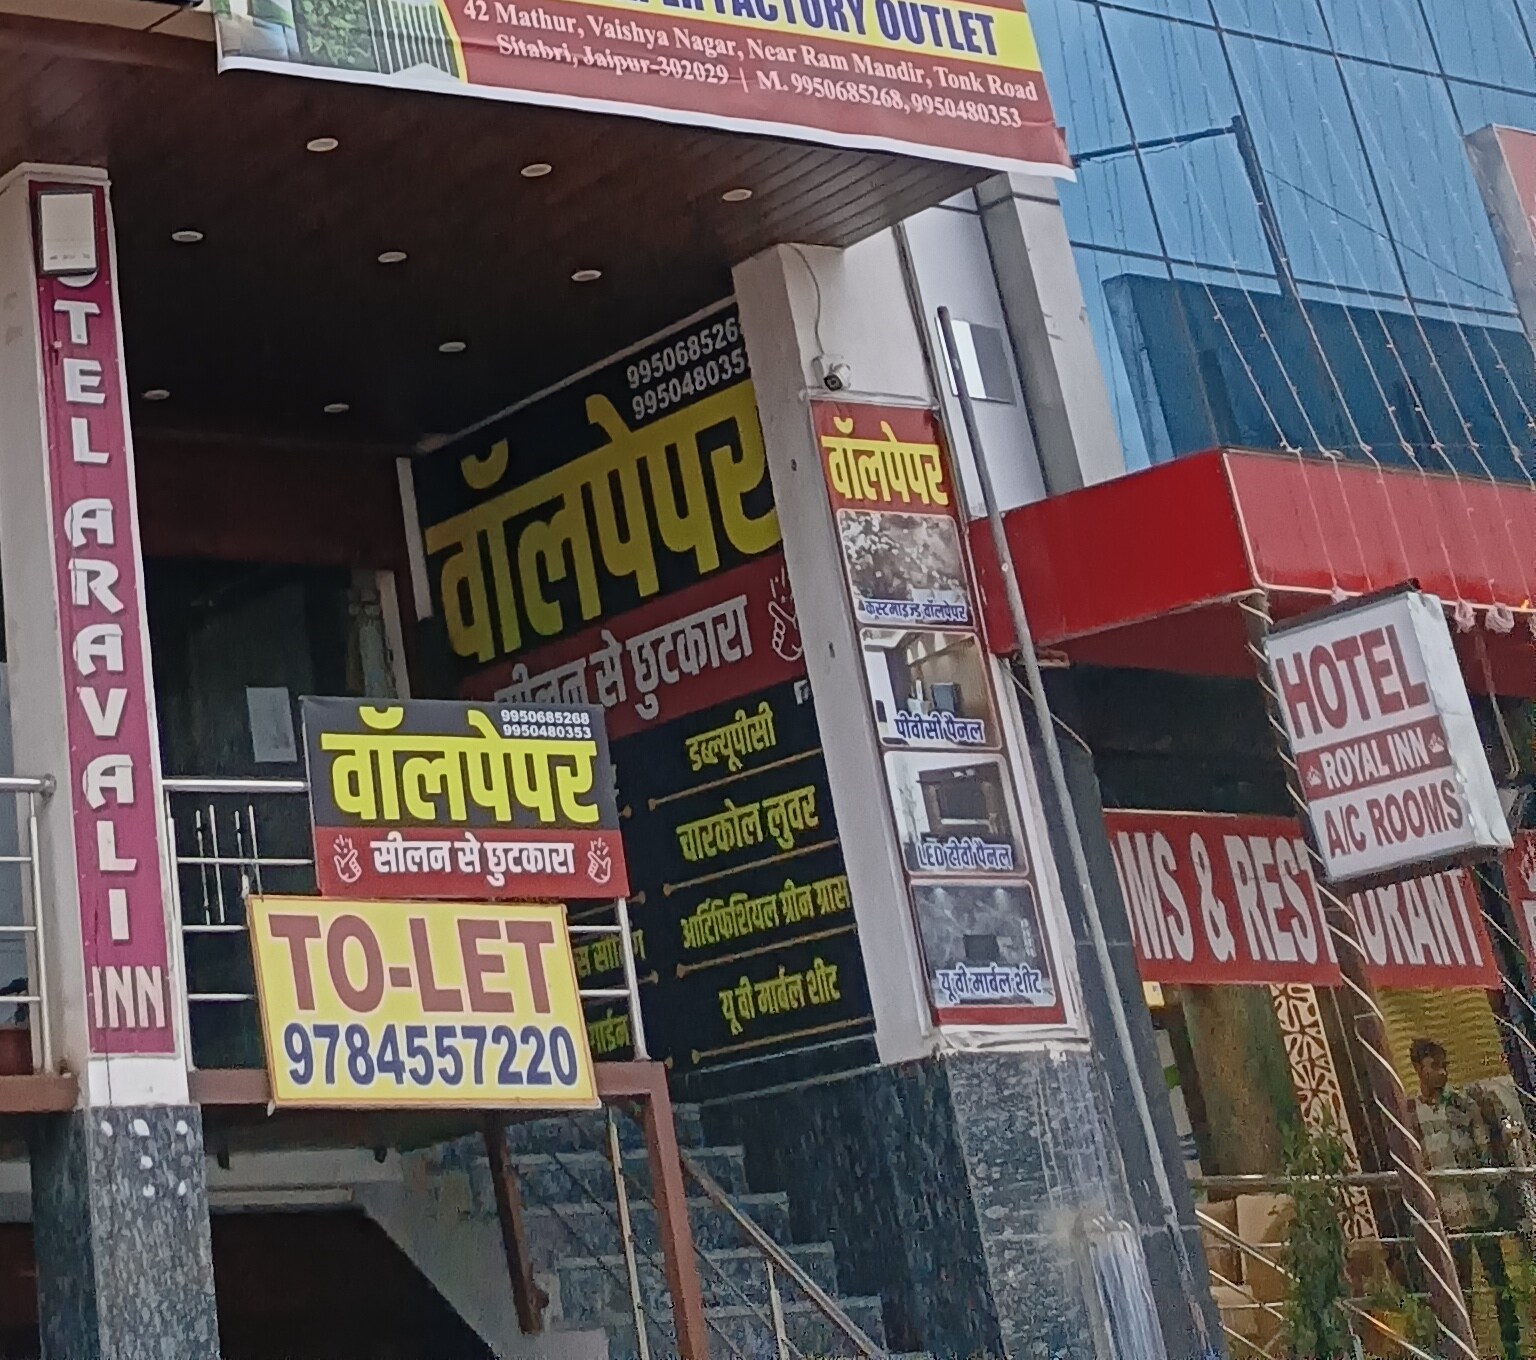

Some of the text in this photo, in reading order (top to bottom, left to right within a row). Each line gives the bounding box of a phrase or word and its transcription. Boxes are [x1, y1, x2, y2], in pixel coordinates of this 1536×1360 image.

[493, 1, 585, 38] Mathur,
[586, 14, 669, 50] Vaishya
[672, 27, 744, 61] Nagar,
[746, 38, 797, 62] Near
[803, 45, 848, 71] Ram
[853, 53, 932, 89] Mandir,
[932, 66, 985, 93] Tonk
[988, 74, 1039, 101] Road
[583, 45, 730, 85] Jaipur-302029
[53, 271, 110, 465] TEL
[627, 317, 738, 389] 995068526
[632, 348, 745, 420] 995048035
[821, 416, 949, 506] वॉलपेपर
[424, 380, 782, 664] वॉलपेपर
[589, 629, 627, 707] से
[626, 595, 753, 721] छुटकारा
[1275, 624, 1431, 740] HOTEL
[64, 497, 137, 941] ARAVALI
[500, 709, 590, 725] 9950685268
[503, 724, 592, 739] 9950480353
[321, 705, 599, 823] वॉलपेपर
[1320, 726, 1431, 791] ROYAL INN
[676, 798, 764, 861] चारकोल
[917, 844, 945, 868] LED
[1324, 779, 1464, 860] A/C ROOMS
[369, 831, 576, 887] सीलन से छुटकारा
[1190, 832, 1237, 962] &
[1223, 834, 1484, 966] RESTURANT
[92, 966, 165, 1029] INN
[268, 914, 555, 1014] TO-LET
[284, 1022, 578, 1087] 9784557220
